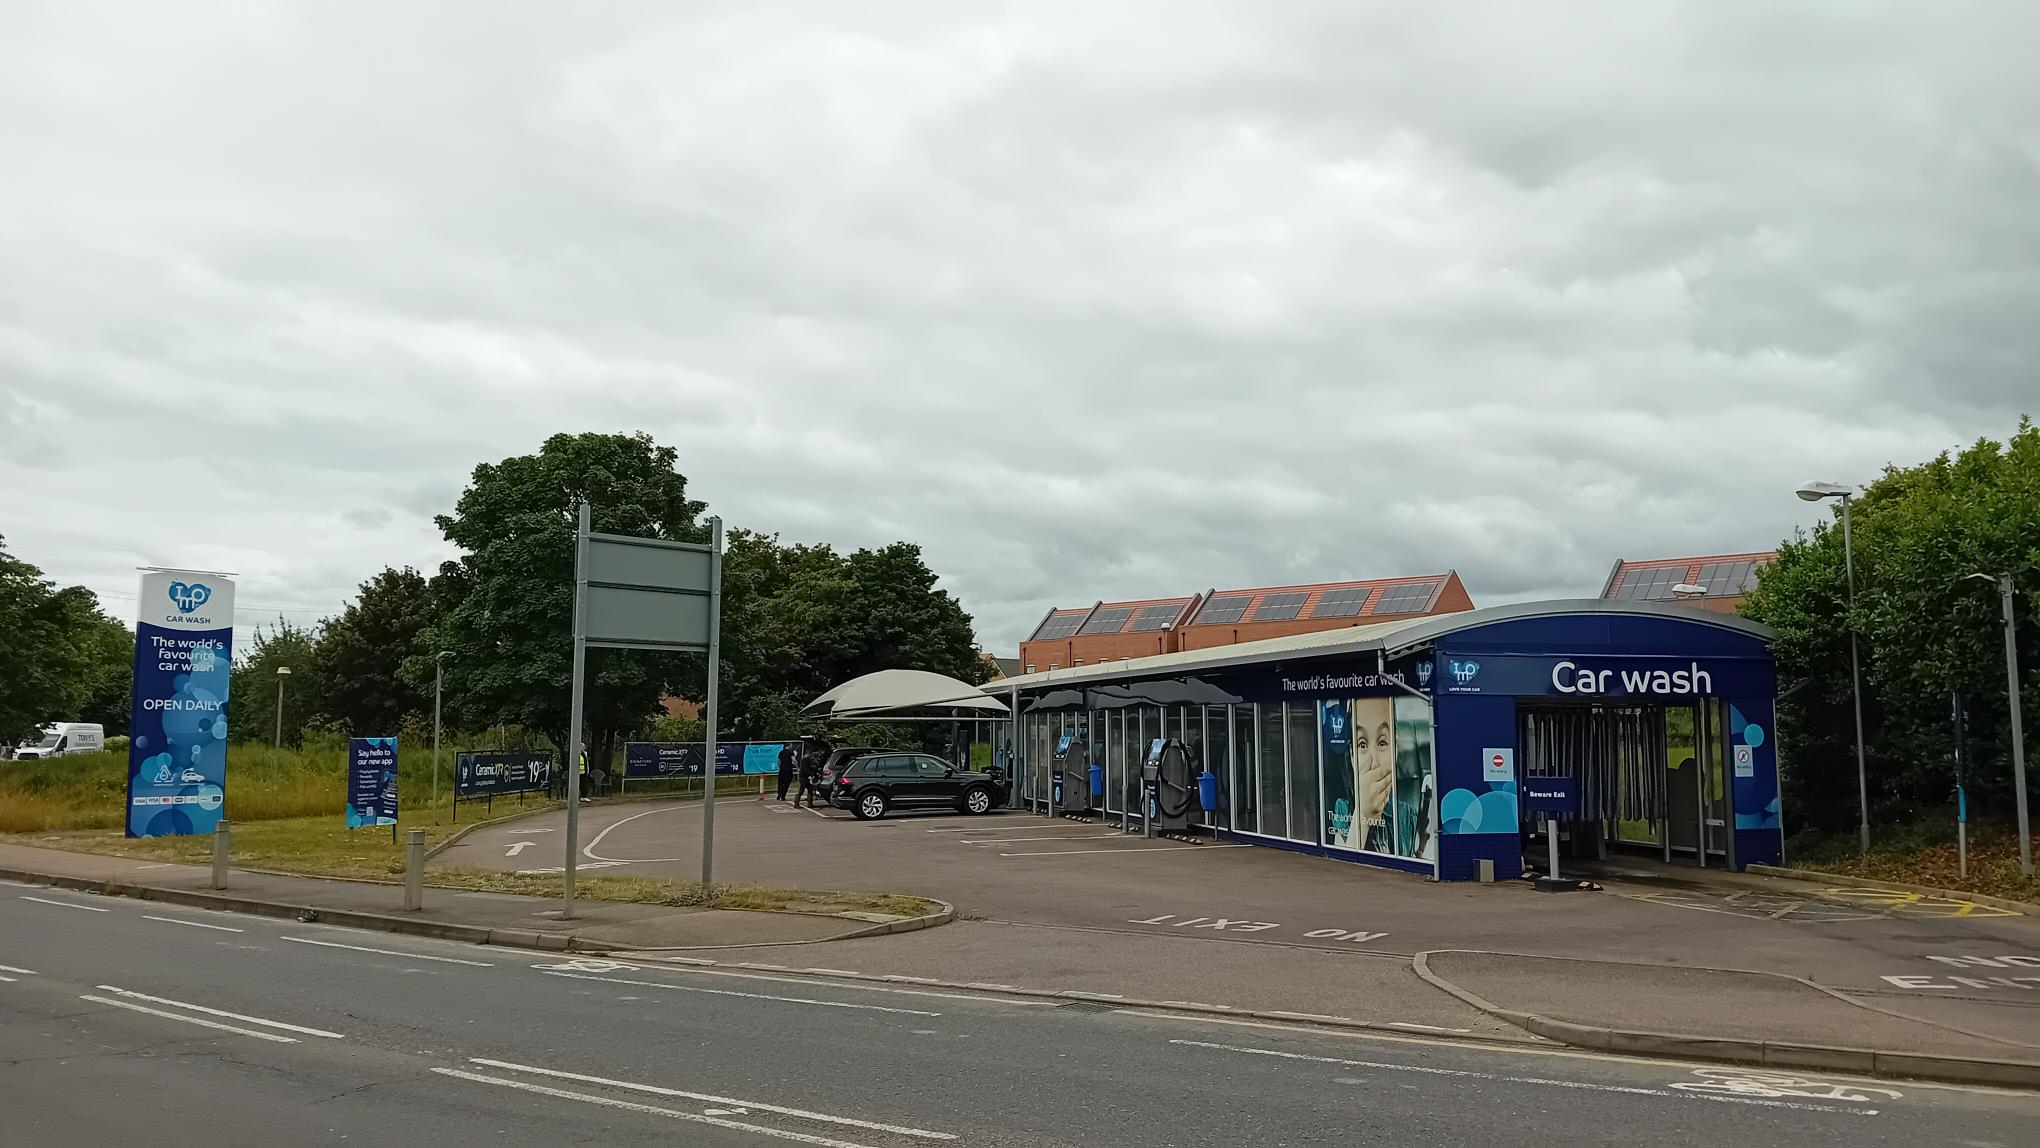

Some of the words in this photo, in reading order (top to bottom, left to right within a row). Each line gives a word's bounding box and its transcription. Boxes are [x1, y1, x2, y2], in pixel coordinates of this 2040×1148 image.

[166, 615, 183, 623] CAR
[185, 616, 211, 624] WASH
[151, 636, 175, 648] The
[177, 638, 224, 650] world's
[158, 648, 216, 660] favourite
[158, 662, 179, 671] car
[181, 662, 214, 672] wash
[1282, 678, 1296, 691] The
[1297, 675, 1325, 690] world's
[1326, 673, 1363, 688] favourite
[1364, 674, 1379, 686] car
[1380, 669, 1405, 686] wash
[1552, 661, 1613, 693] Car
[1621, 661, 1712, 693] wash
[143, 699, 182, 710] OPEN
[185, 700, 222, 711] DAILY
[358, 749, 369, 758] Say
[381, 758, 393, 766] app
[1128, 914, 1281, 932] EXIT
